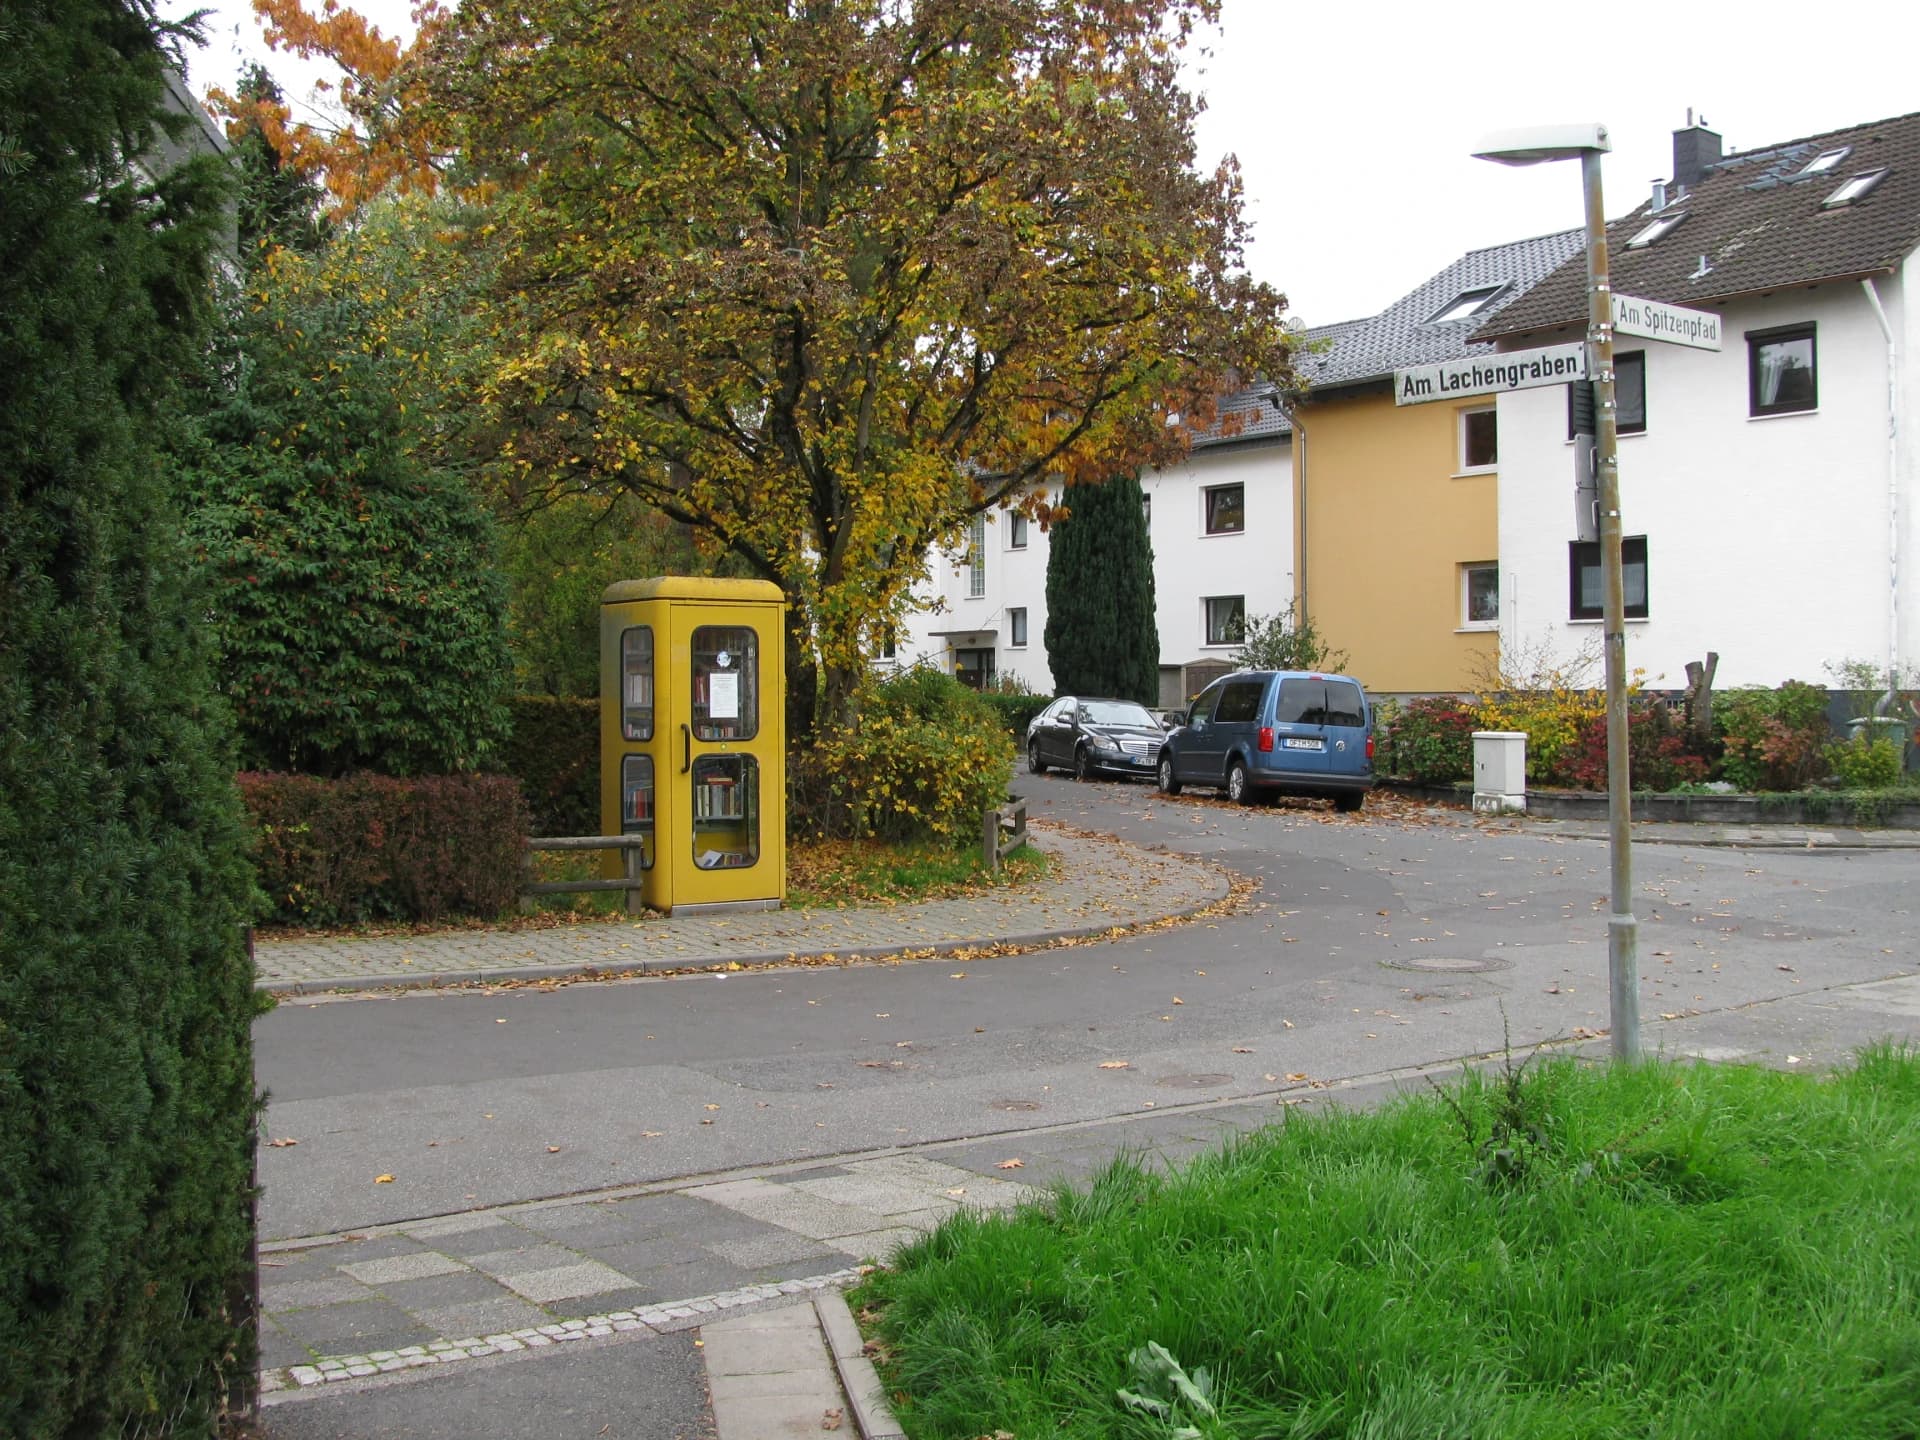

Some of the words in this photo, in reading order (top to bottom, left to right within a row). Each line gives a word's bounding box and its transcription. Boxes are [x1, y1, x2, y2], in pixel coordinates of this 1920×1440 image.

[1620, 300, 1640, 325] Am
[1644, 305, 1717, 342] Spitzenpfad
[1403, 375, 1432, 397] Am
[1439, 355, 1577, 388] Lachengraben
